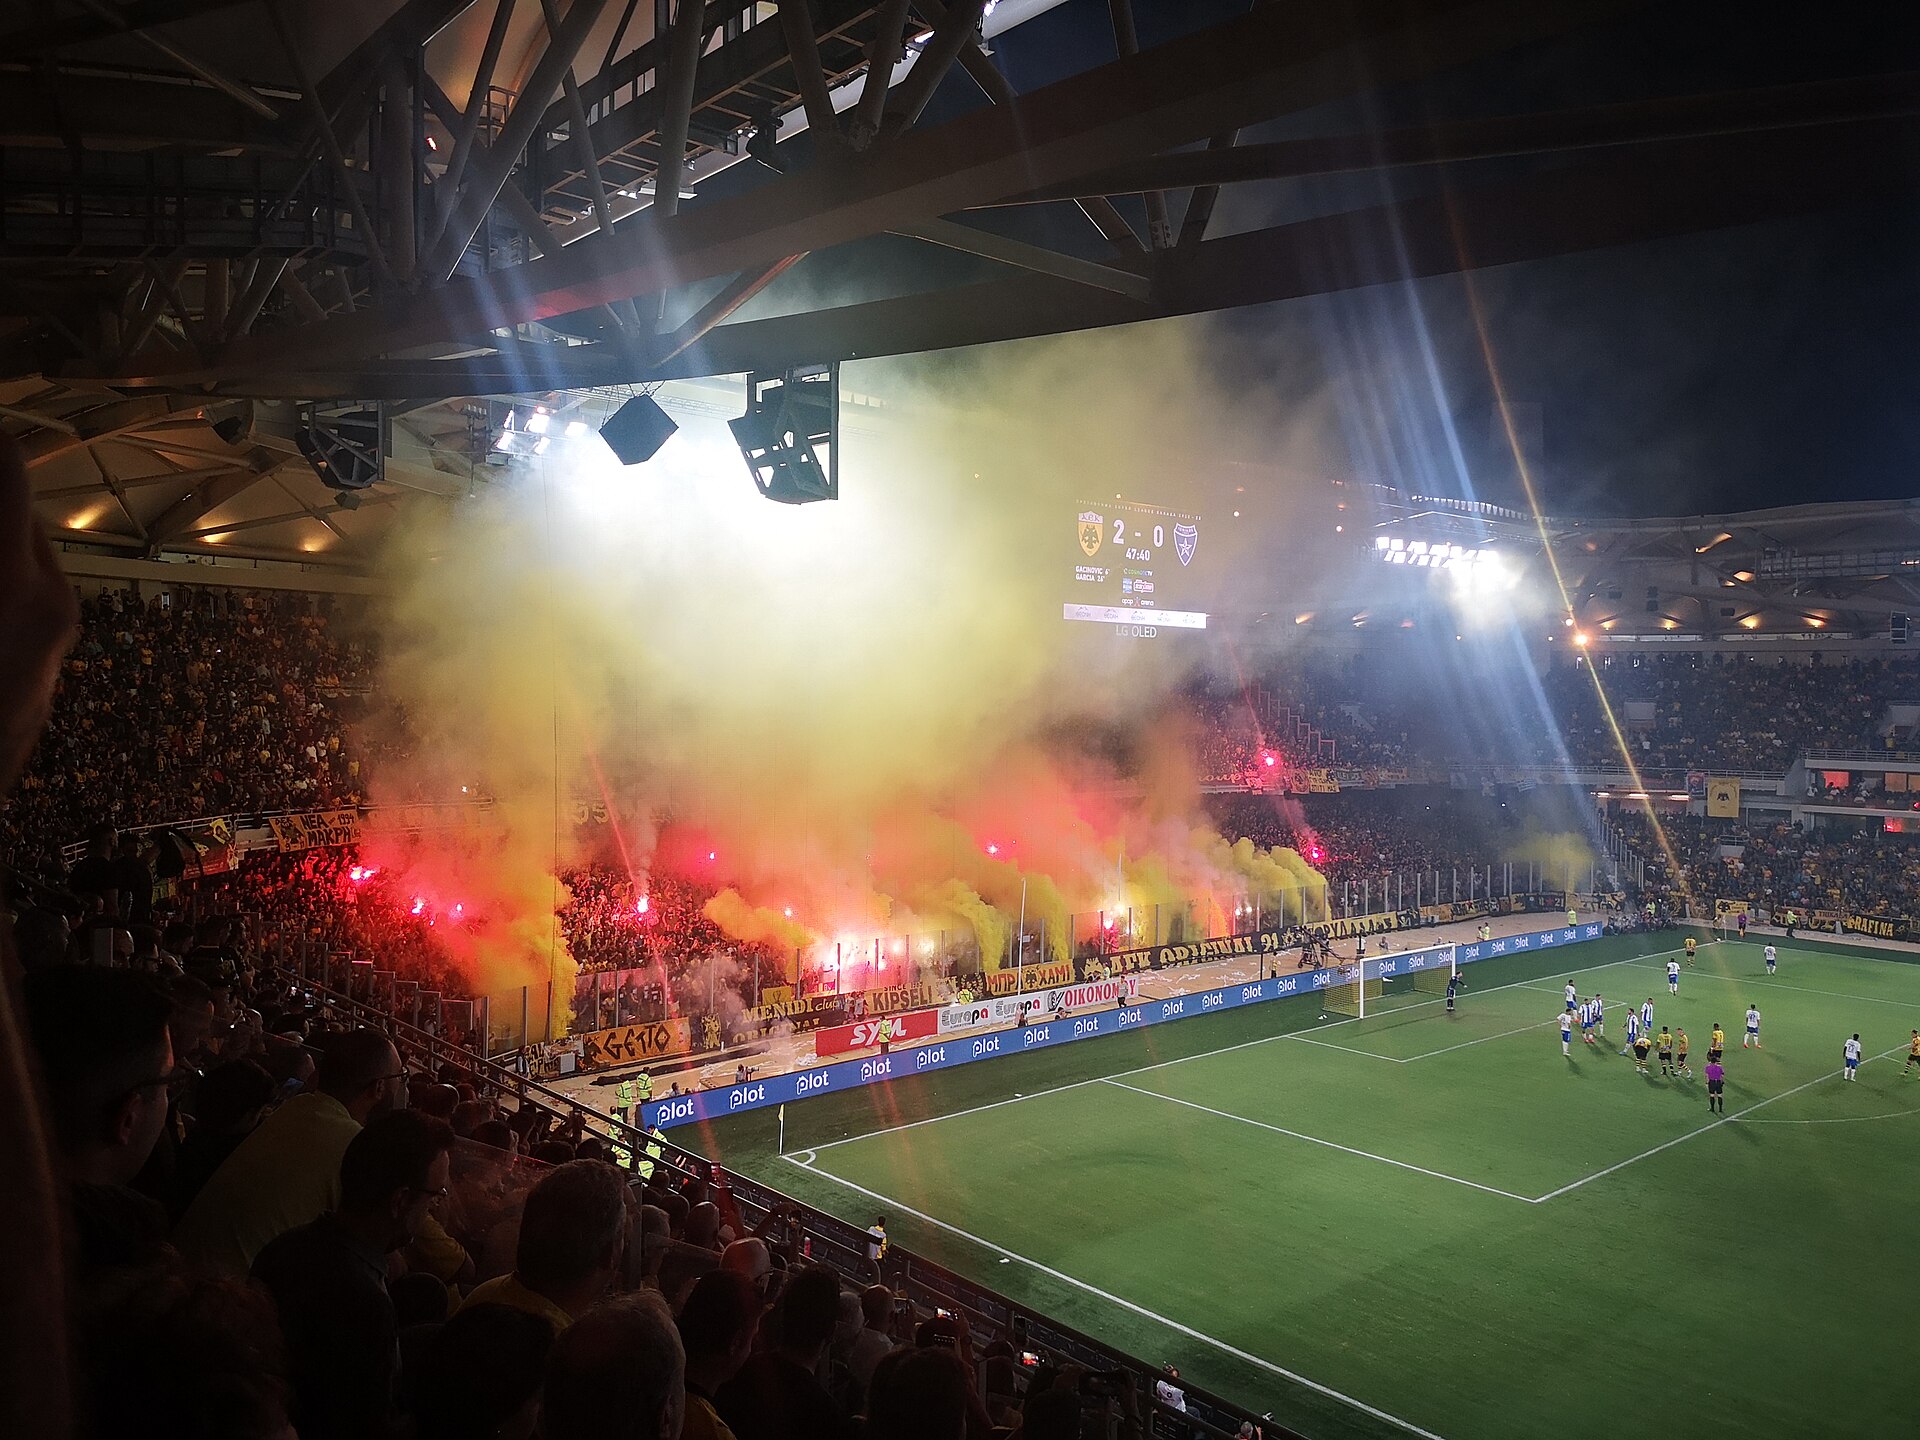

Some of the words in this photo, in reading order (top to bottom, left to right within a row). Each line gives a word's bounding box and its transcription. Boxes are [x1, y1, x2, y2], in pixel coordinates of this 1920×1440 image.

[1113, 519, 1125, 545] 2
[1153, 525, 1164, 548] 0
[1125, 547, 1150, 561] 47:40
[1075, 573, 1096, 582] GARCIA
[1115, 625, 1128, 637] LG
[1131, 626, 1157, 638] OLED
[1855, 917, 1894, 937] RAFINA
[1260, 932, 1278, 951] 21
[872, 986, 933, 1012] KIPSELI
[742, 998, 813, 1023] MENIDI
[941, 1007, 989, 1028] Europa
[603, 1024, 671, 1060] GETTO
[657, 1099, 694, 1125] plot
[730, 1085, 765, 1109] plot
[796, 1071, 829, 1095] plot
[861, 1058, 892, 1081] plot
[917, 1047, 945, 1069] plot
[972, 1036, 1000, 1057] plot
[1023, 1025, 1049, 1047] plot
[1074, 1017, 1099, 1037] plot
[1118, 1008, 1141, 1028] plot
[1162, 1000, 1184, 1019] plot
[1202, 992, 1223, 1010] plot
[1242, 986, 1262, 1003] plot
[1346, 966, 1360, 981] plo
